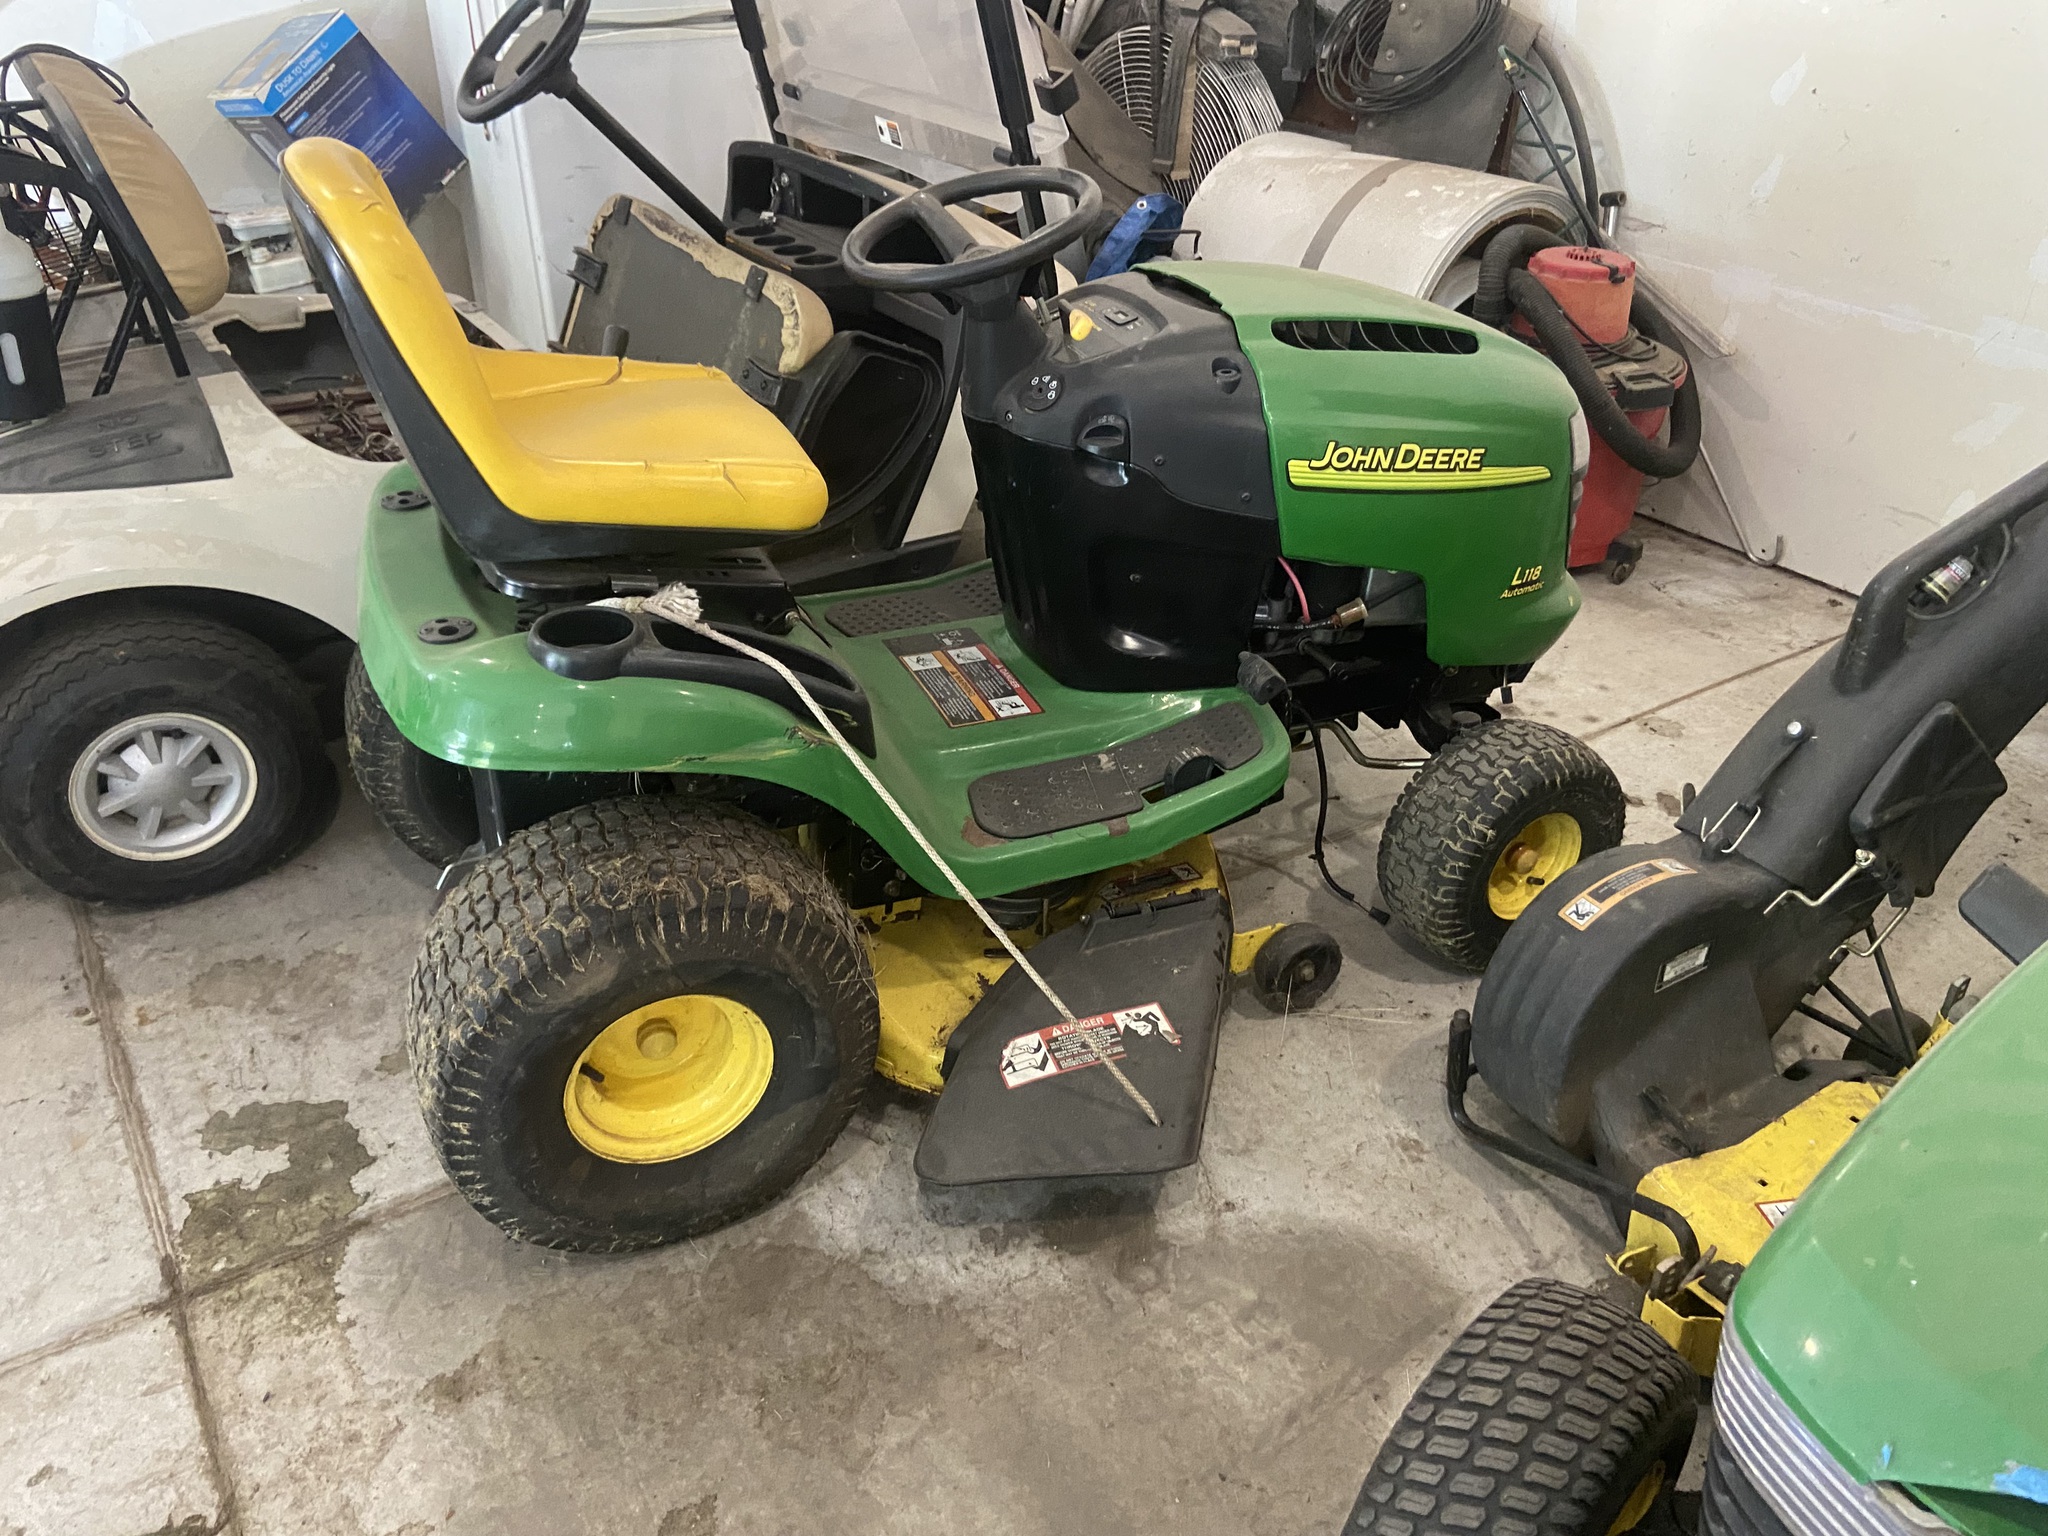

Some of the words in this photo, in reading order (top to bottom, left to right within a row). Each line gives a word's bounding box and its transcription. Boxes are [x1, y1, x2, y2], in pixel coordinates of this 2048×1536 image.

[275, 74, 293, 93] DUSK
[292, 66, 302, 76] TO
[300, 49, 321, 68] DAWN
[88, 432, 163, 457] STEP
[1308, 441, 1395, 470] JOHN
[1392, 442, 1486, 471] DEERE
[1511, 565, 1542, 586] L118
[1500, 580, 1545, 600] Automatic
[955, 675, 976, 697] WARNING
[1001, 668, 1021, 689] DANGER
